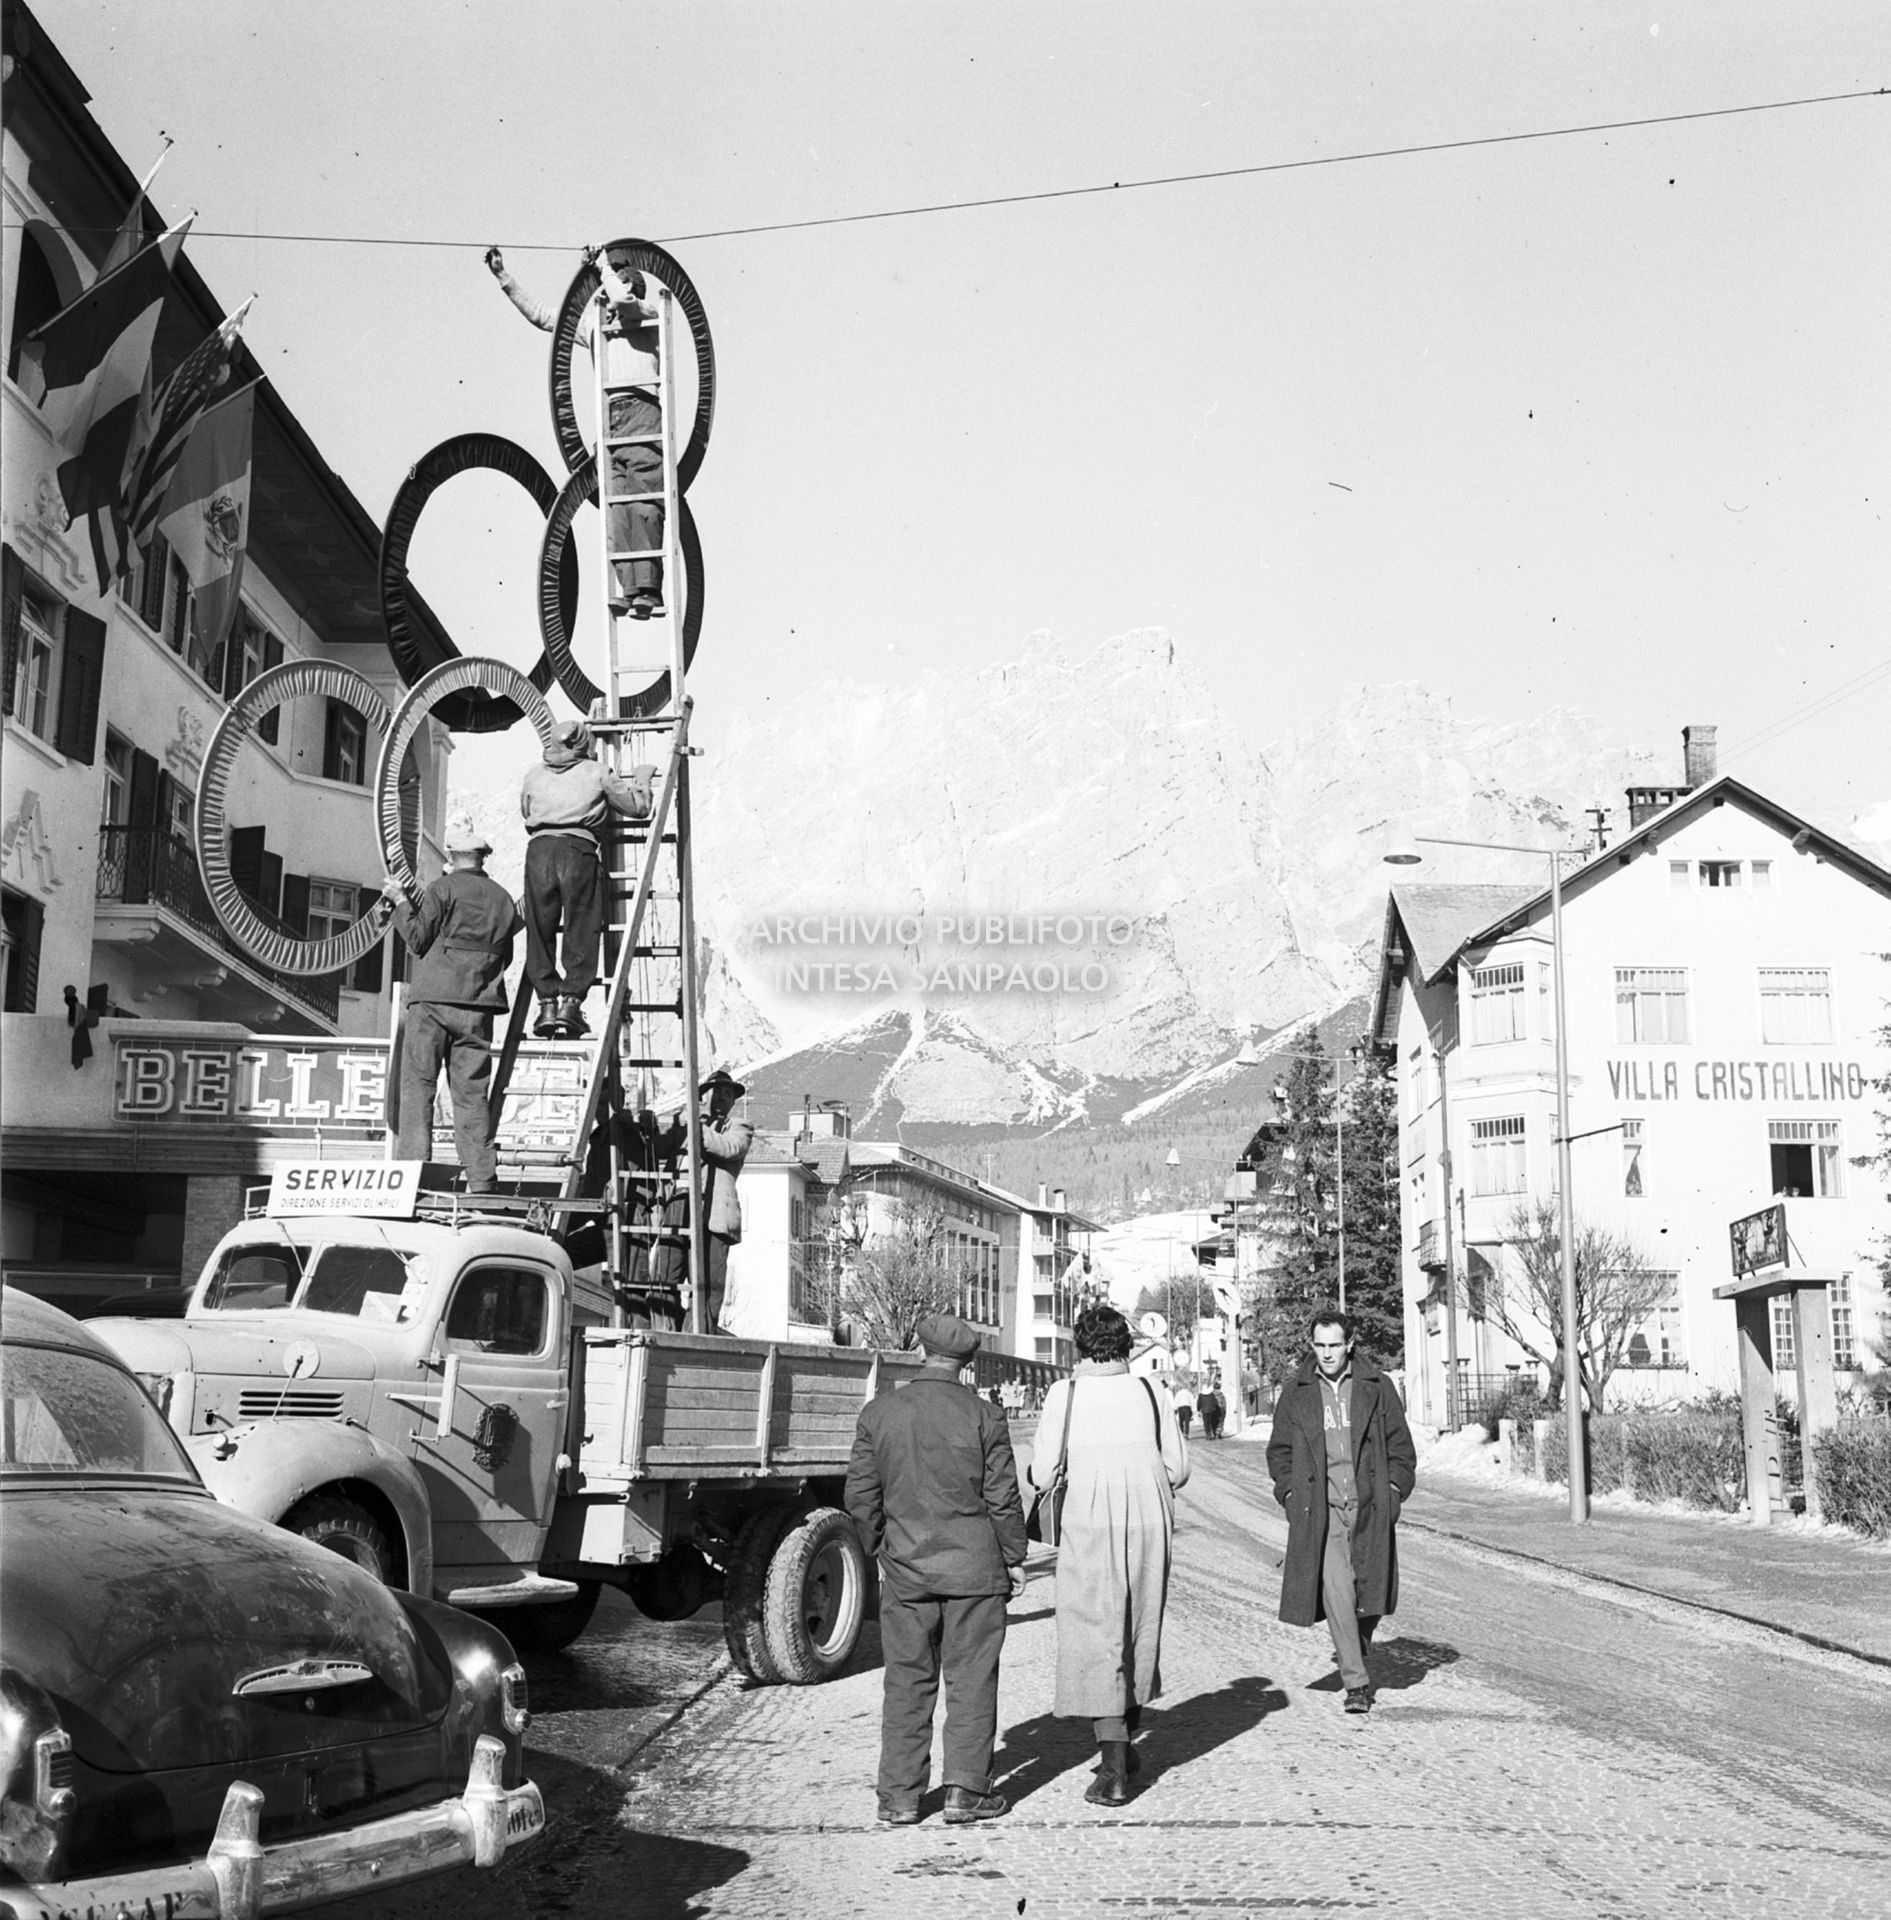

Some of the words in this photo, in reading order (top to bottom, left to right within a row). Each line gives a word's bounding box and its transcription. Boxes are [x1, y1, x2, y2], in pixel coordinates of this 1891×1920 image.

[1607, 1061, 1678, 1100] VILLA
[1695, 1062, 1863, 1100] CRISTALLINO
[286, 1169, 404, 1190] SERVIZIO
[280, 1197, 327, 1209] DIREZIONE
[329, 1198, 362, 1209] SERVIZI
